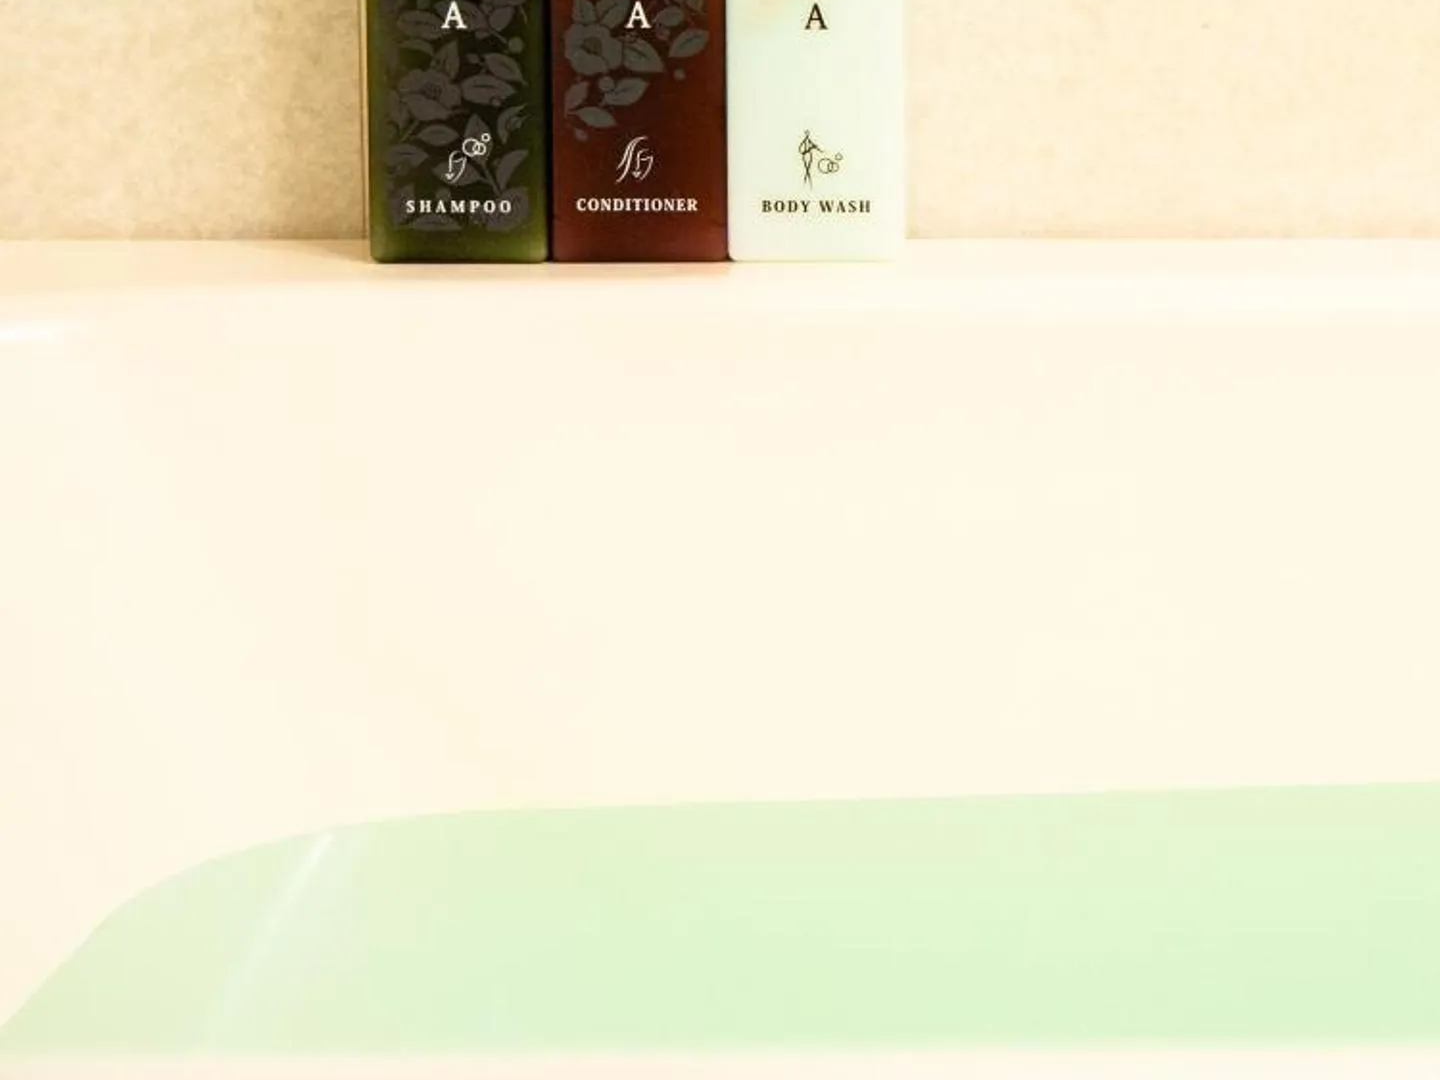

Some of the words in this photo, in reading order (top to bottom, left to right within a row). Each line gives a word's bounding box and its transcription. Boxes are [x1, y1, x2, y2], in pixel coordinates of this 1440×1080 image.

[406, 200, 512, 213] SHAMPOO
[576, 197, 698, 212] CONDITIONER
[762, 200, 810, 213] BODY
[819, 200, 871, 213] WASH
